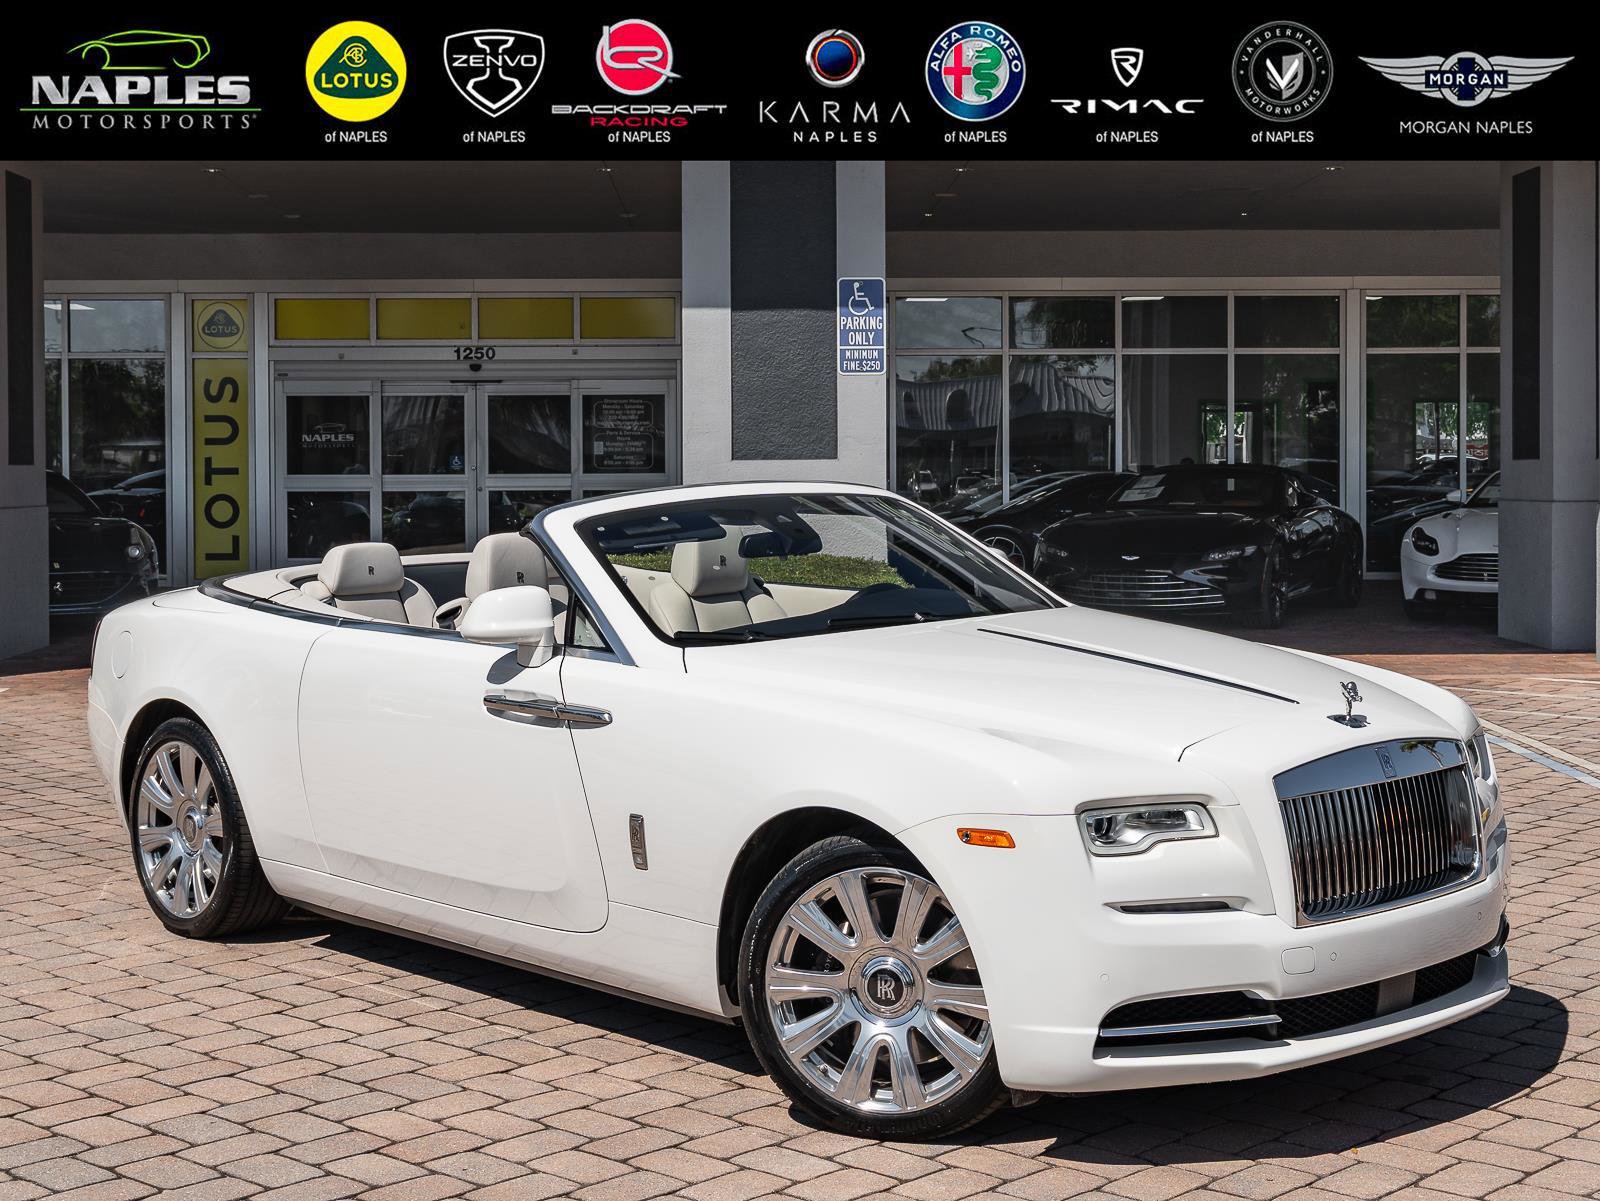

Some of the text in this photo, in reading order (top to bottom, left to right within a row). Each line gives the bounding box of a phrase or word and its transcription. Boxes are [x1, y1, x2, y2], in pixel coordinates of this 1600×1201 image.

[840, 316, 883, 330] PARKING
[204, 325, 238, 334] LOTUS
[848, 331, 875, 345] ONLY
[453, 346, 497, 360] 1250
[845, 349, 879, 360] MINIMUM
[843, 360, 881, 371] FINE $250
[301, 433, 355, 442] NAPLES
[203, 375, 241, 562] LOTUS
